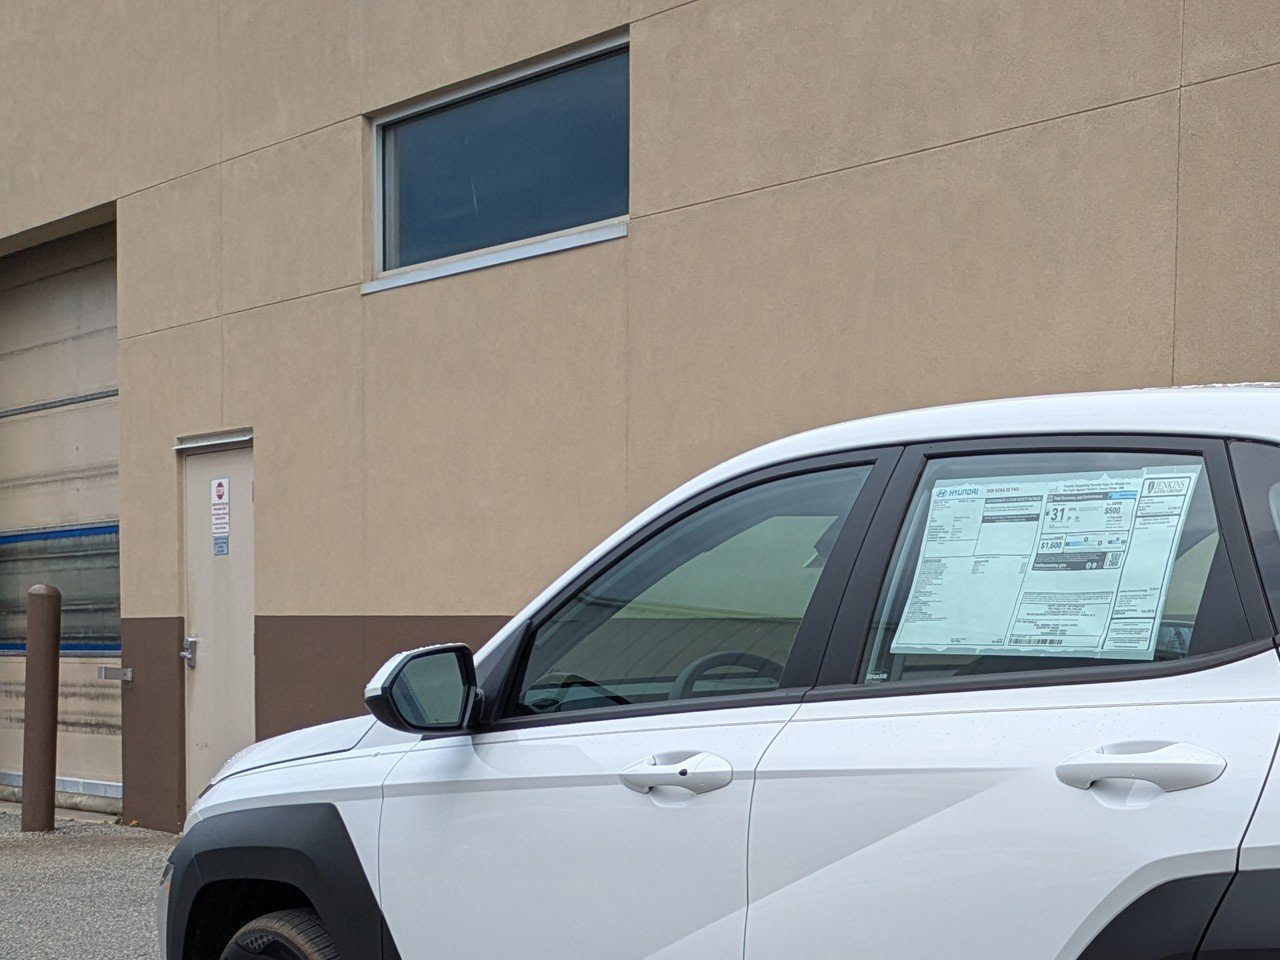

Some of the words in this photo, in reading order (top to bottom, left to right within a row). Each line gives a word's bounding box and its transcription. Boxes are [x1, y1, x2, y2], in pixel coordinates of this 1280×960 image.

[1155, 481, 1185, 490] JENKINS
[948, 488, 978, 496] HYUNDAI
[1051, 508, 1065, 521] 31
[1104, 507, 1121, 515] $500
[1041, 542, 1062, 550] $1,600
